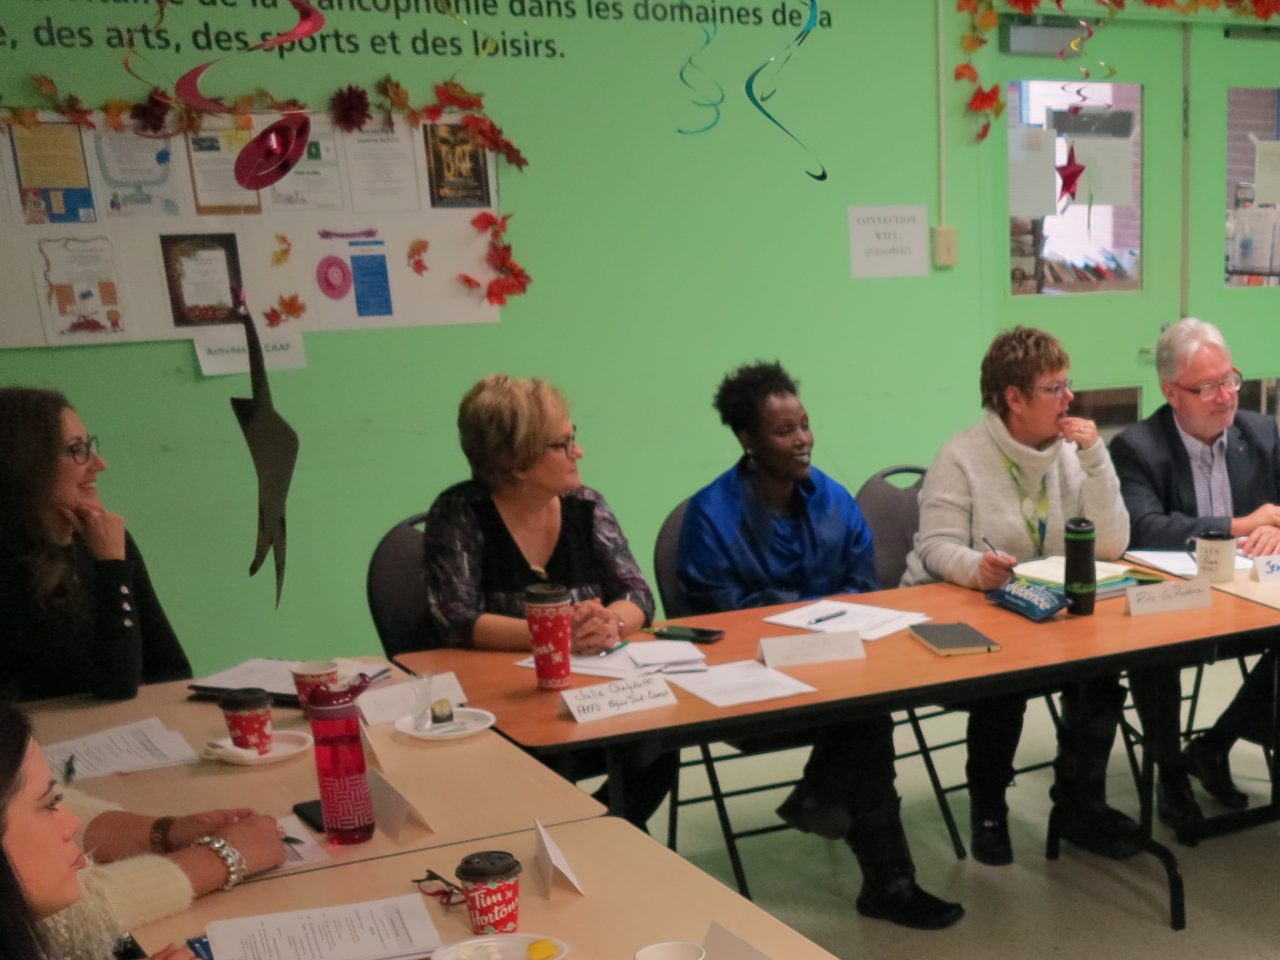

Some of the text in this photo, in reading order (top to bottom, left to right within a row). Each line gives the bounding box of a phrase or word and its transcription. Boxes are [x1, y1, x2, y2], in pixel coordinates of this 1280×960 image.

[316, 0, 497, 20] ancophonie
[509, 0, 577, 20] dans
[587, 0, 624, 21] les
[633, 0, 764, 26] domaines
[771, 2, 802, 27] de
[34, 16, 94, 48] des
[105, 24, 182, 54] arts,
[191, 21, 249, 53] des
[260, 28, 361, 60] sports
[369, 30, 402, 55] et
[410, 28, 463, 57] des
[473, 28, 566, 59] loisirs.
[206, 347, 247, 356] Activités
[469, 888, 502, 910] Tim
